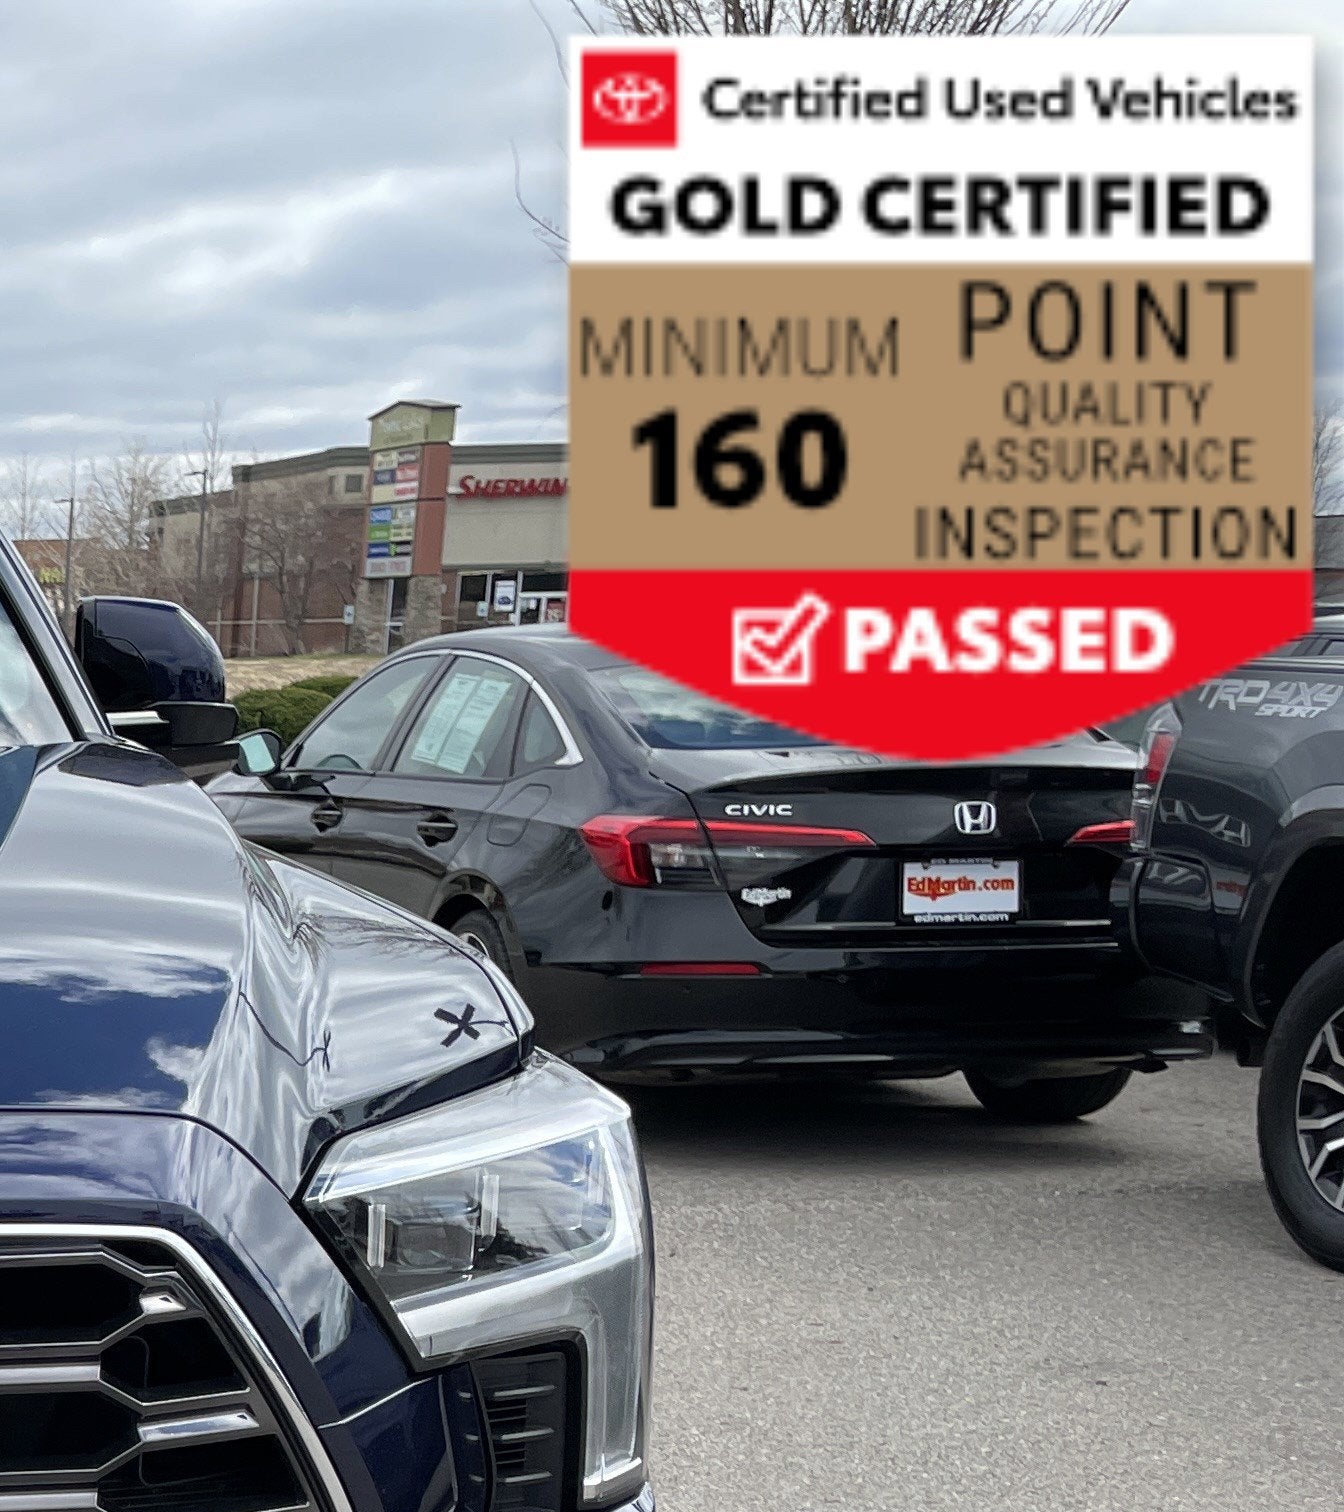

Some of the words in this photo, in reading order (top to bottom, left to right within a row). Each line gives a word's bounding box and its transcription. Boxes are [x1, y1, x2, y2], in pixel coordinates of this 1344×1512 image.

[456, 475, 569, 498] SHERWIN
[1198, 678, 1272, 711] TRD
[1269, 681, 1343, 707] 4X4
[1254, 703, 1329, 719] SPORT
[724, 803, 794, 817] CIVIC
[907, 876, 1015, 901] EdMartin.com
